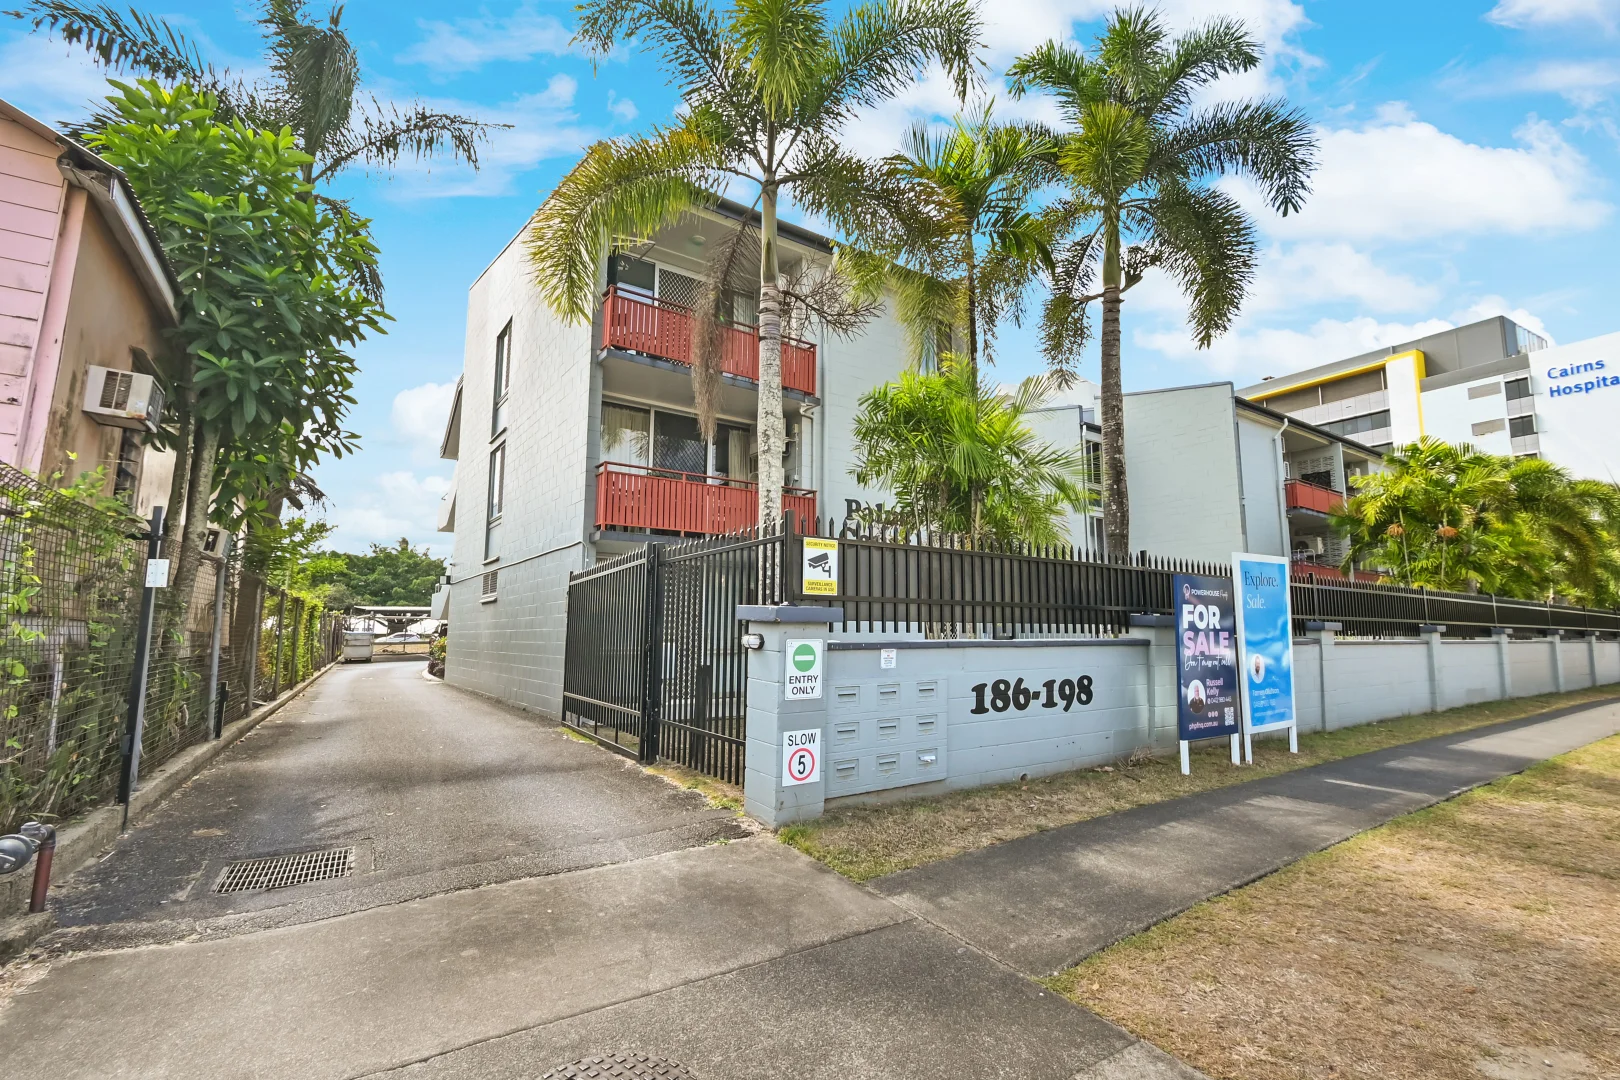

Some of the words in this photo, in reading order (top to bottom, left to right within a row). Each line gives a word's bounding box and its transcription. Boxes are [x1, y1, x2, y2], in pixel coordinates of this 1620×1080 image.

[1547, 359, 1605, 379] Cairns
[1244, 571, 1279, 590] Explore.
[1191, 588, 1220, 597] POWERHOUSE
[1246, 593, 1267, 609] Sale.
[1182, 604, 1221, 629] FOR
[1183, 630, 1230, 656] SALE
[789, 675, 819, 685] ENTRY
[1206, 677, 1224, 687] Russell
[791, 685, 816, 695] ONLY
[970, 674, 1094, 715] 186-198
[787, 732, 816, 746] SLOW
[797, 754, 806, 775] 5
